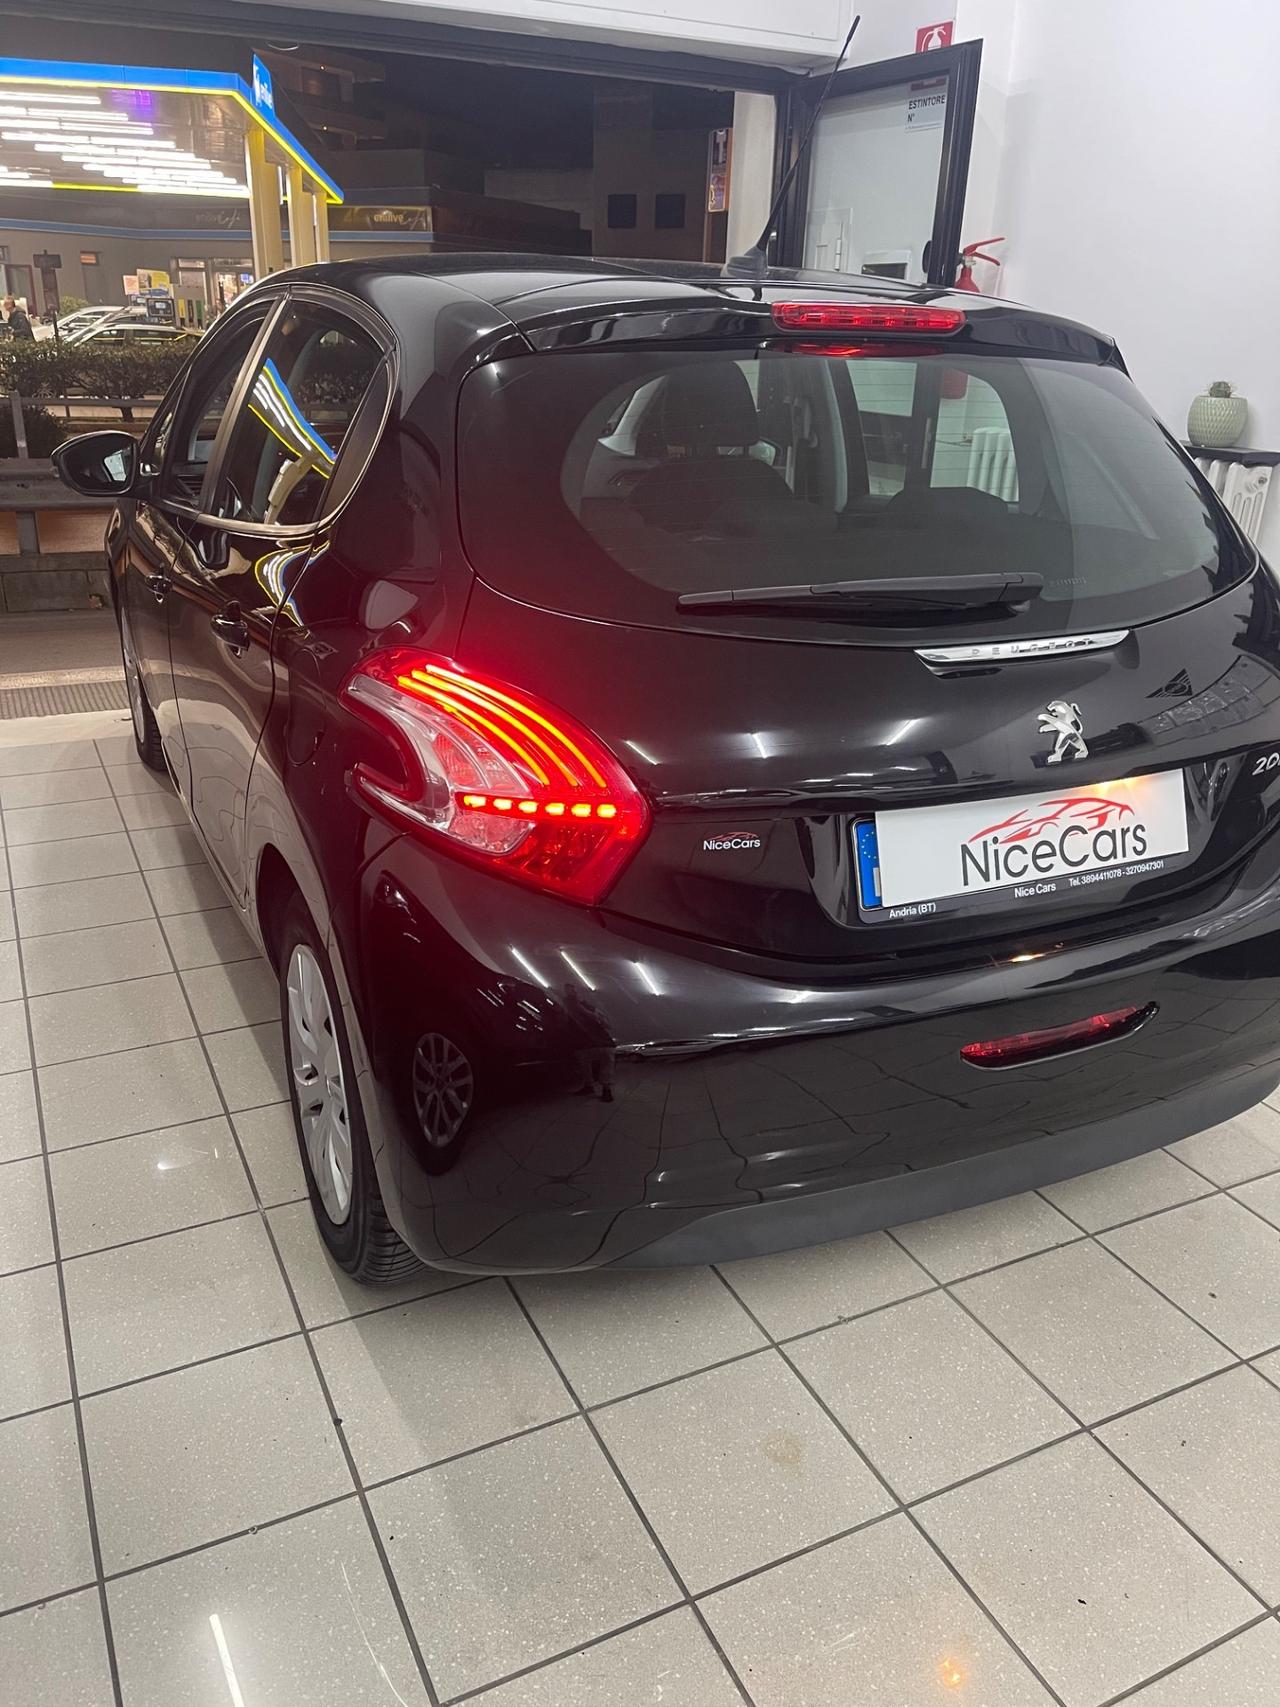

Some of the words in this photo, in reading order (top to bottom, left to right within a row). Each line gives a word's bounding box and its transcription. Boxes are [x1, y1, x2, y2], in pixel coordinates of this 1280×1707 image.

[908, 94, 946, 110] ESTINTORE
[971, 637, 1093, 656] PEUGEOT
[1252, 752, 1280, 776] 20
[703, 838, 761, 851] NiceCars
[960, 823, 1147, 887] NiceCars
[1014, 887, 1036, 898] Nice
[1035, 883, 1057, 894] Cars
[889, 906, 917, 918] Andria
[917, 902, 937, 915] (BT)
